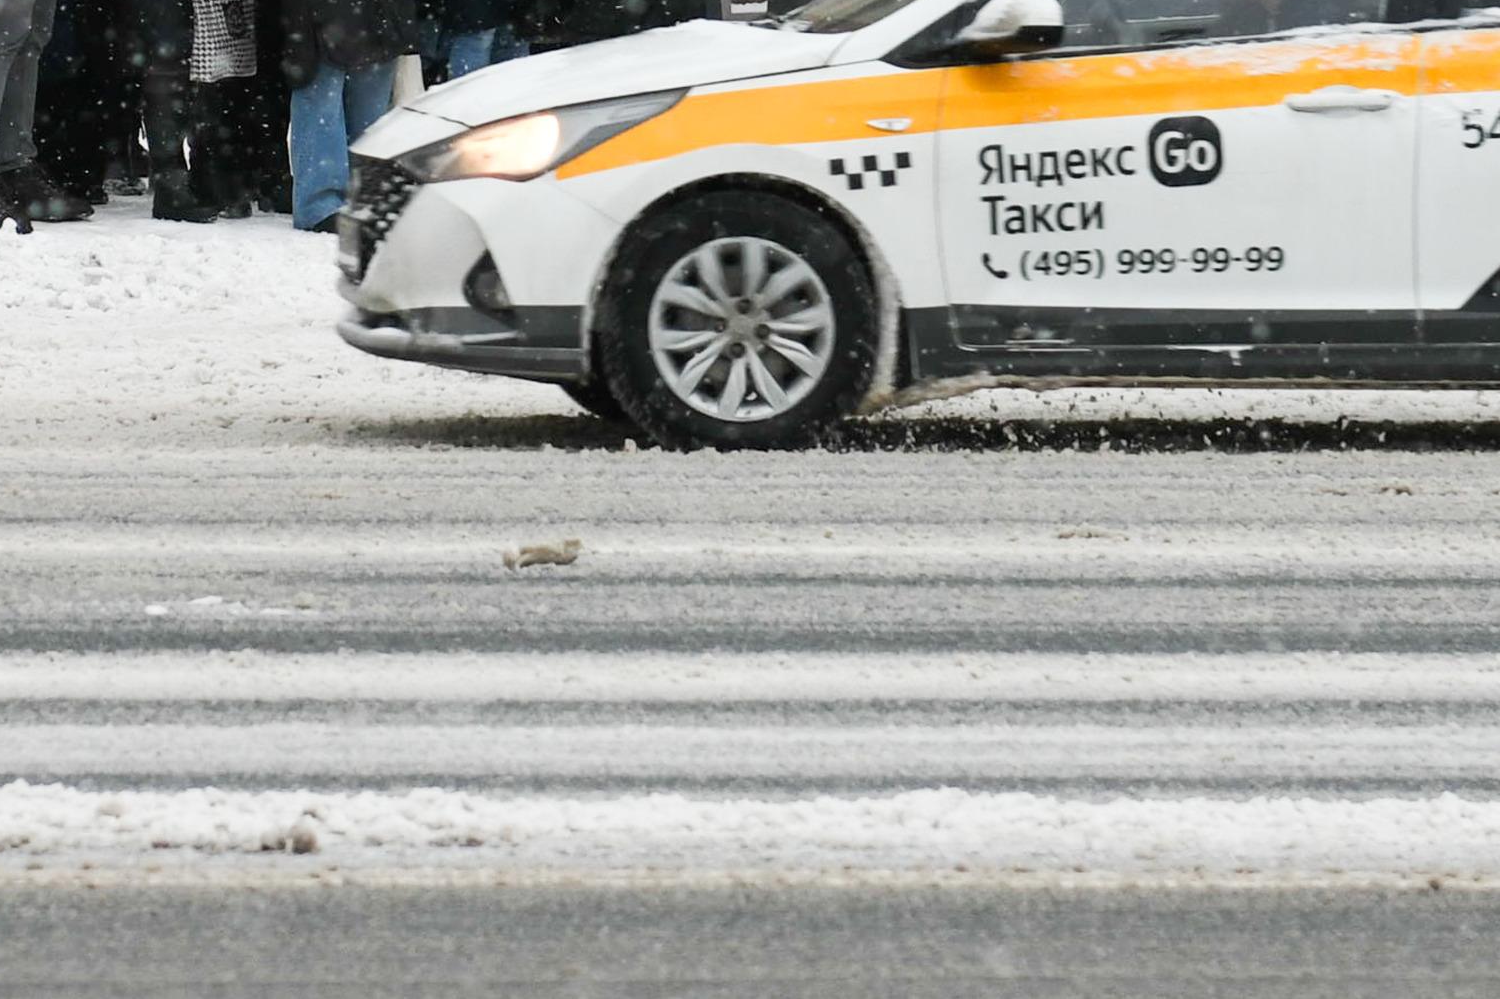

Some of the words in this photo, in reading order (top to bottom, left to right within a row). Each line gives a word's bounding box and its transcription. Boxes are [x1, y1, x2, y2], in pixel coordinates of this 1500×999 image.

[978, 143, 1137, 188] Яндекс
[1154, 129, 1217, 174] Go
[981, 194, 1106, 237] Такси
[1019, 249, 1106, 281] (495)
[1116, 245, 1286, 276] 999-99-99
